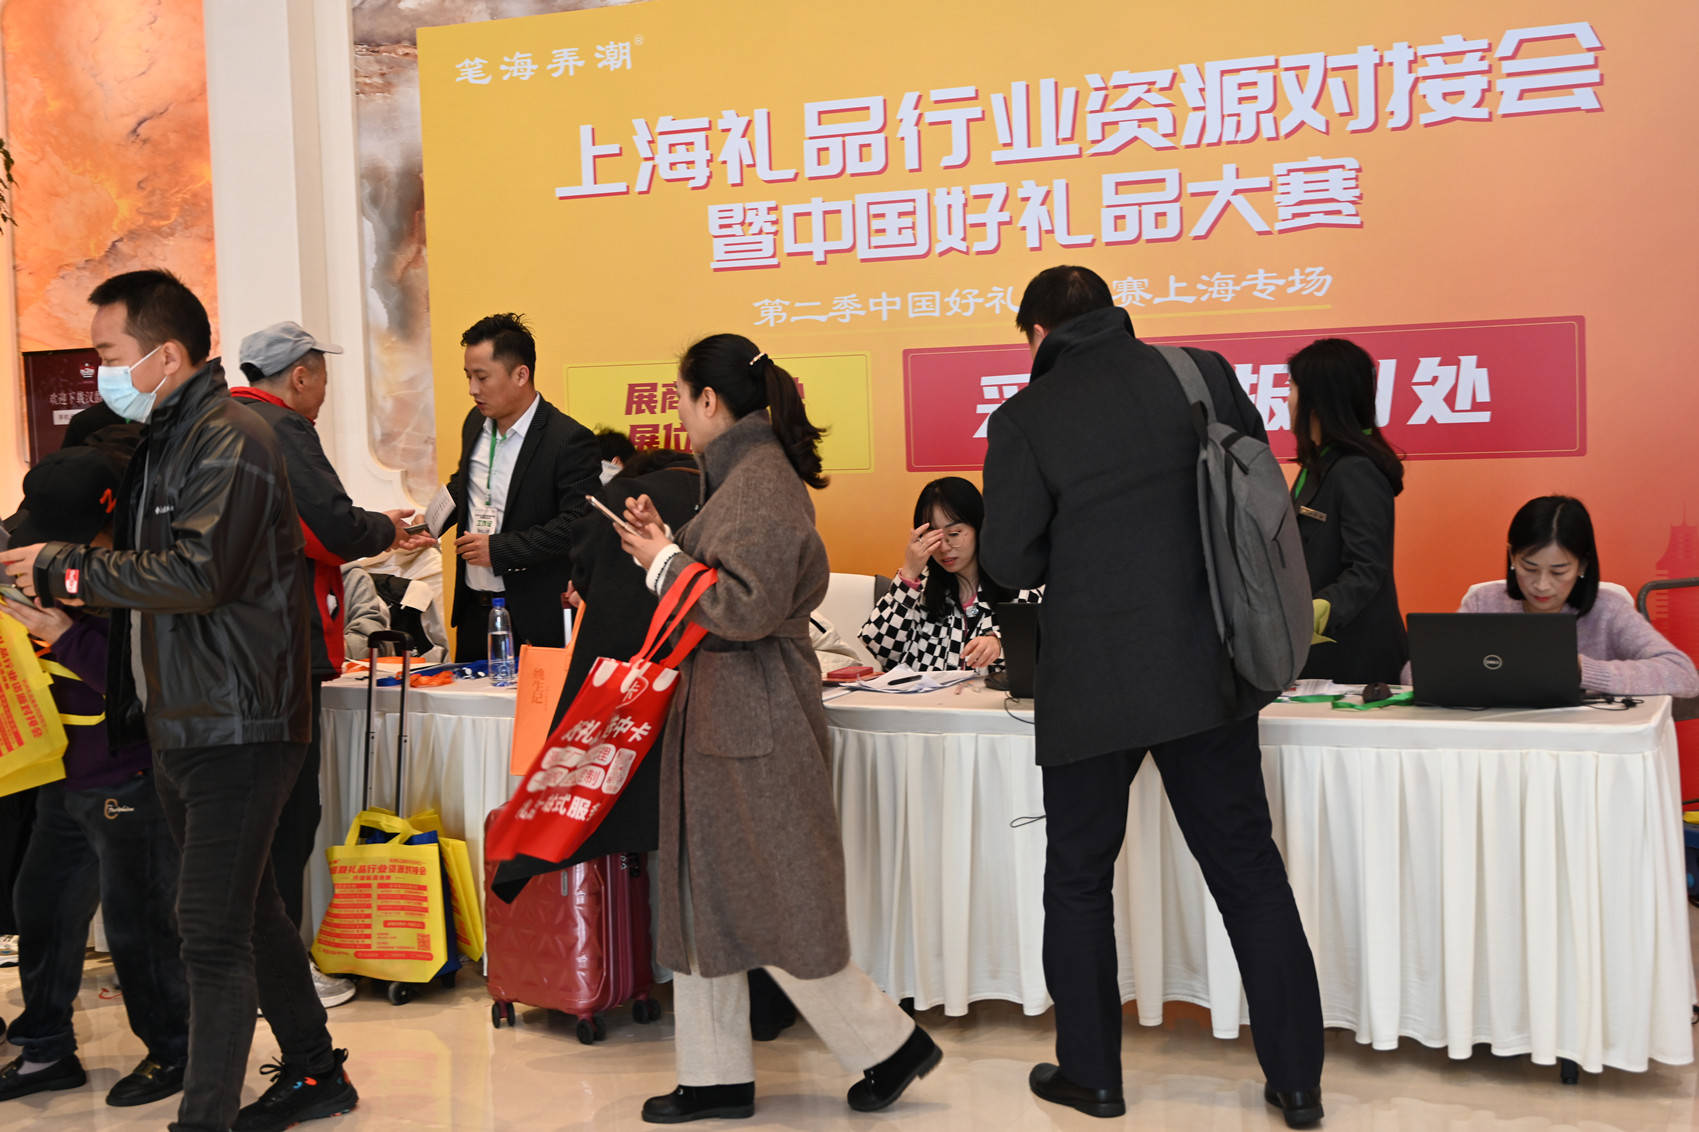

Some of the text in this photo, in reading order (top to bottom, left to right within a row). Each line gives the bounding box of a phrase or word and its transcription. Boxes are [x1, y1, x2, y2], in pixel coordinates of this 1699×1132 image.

[455, 41, 633, 85] 笔海弄潮
[555, 21, 1604, 200] 上海礼品行业资源对接会
[708, 155, 1363, 272] 暨中国好礼品大赛
[752, 266, 1333, 326] 第二季中国好礼赛上海专场
